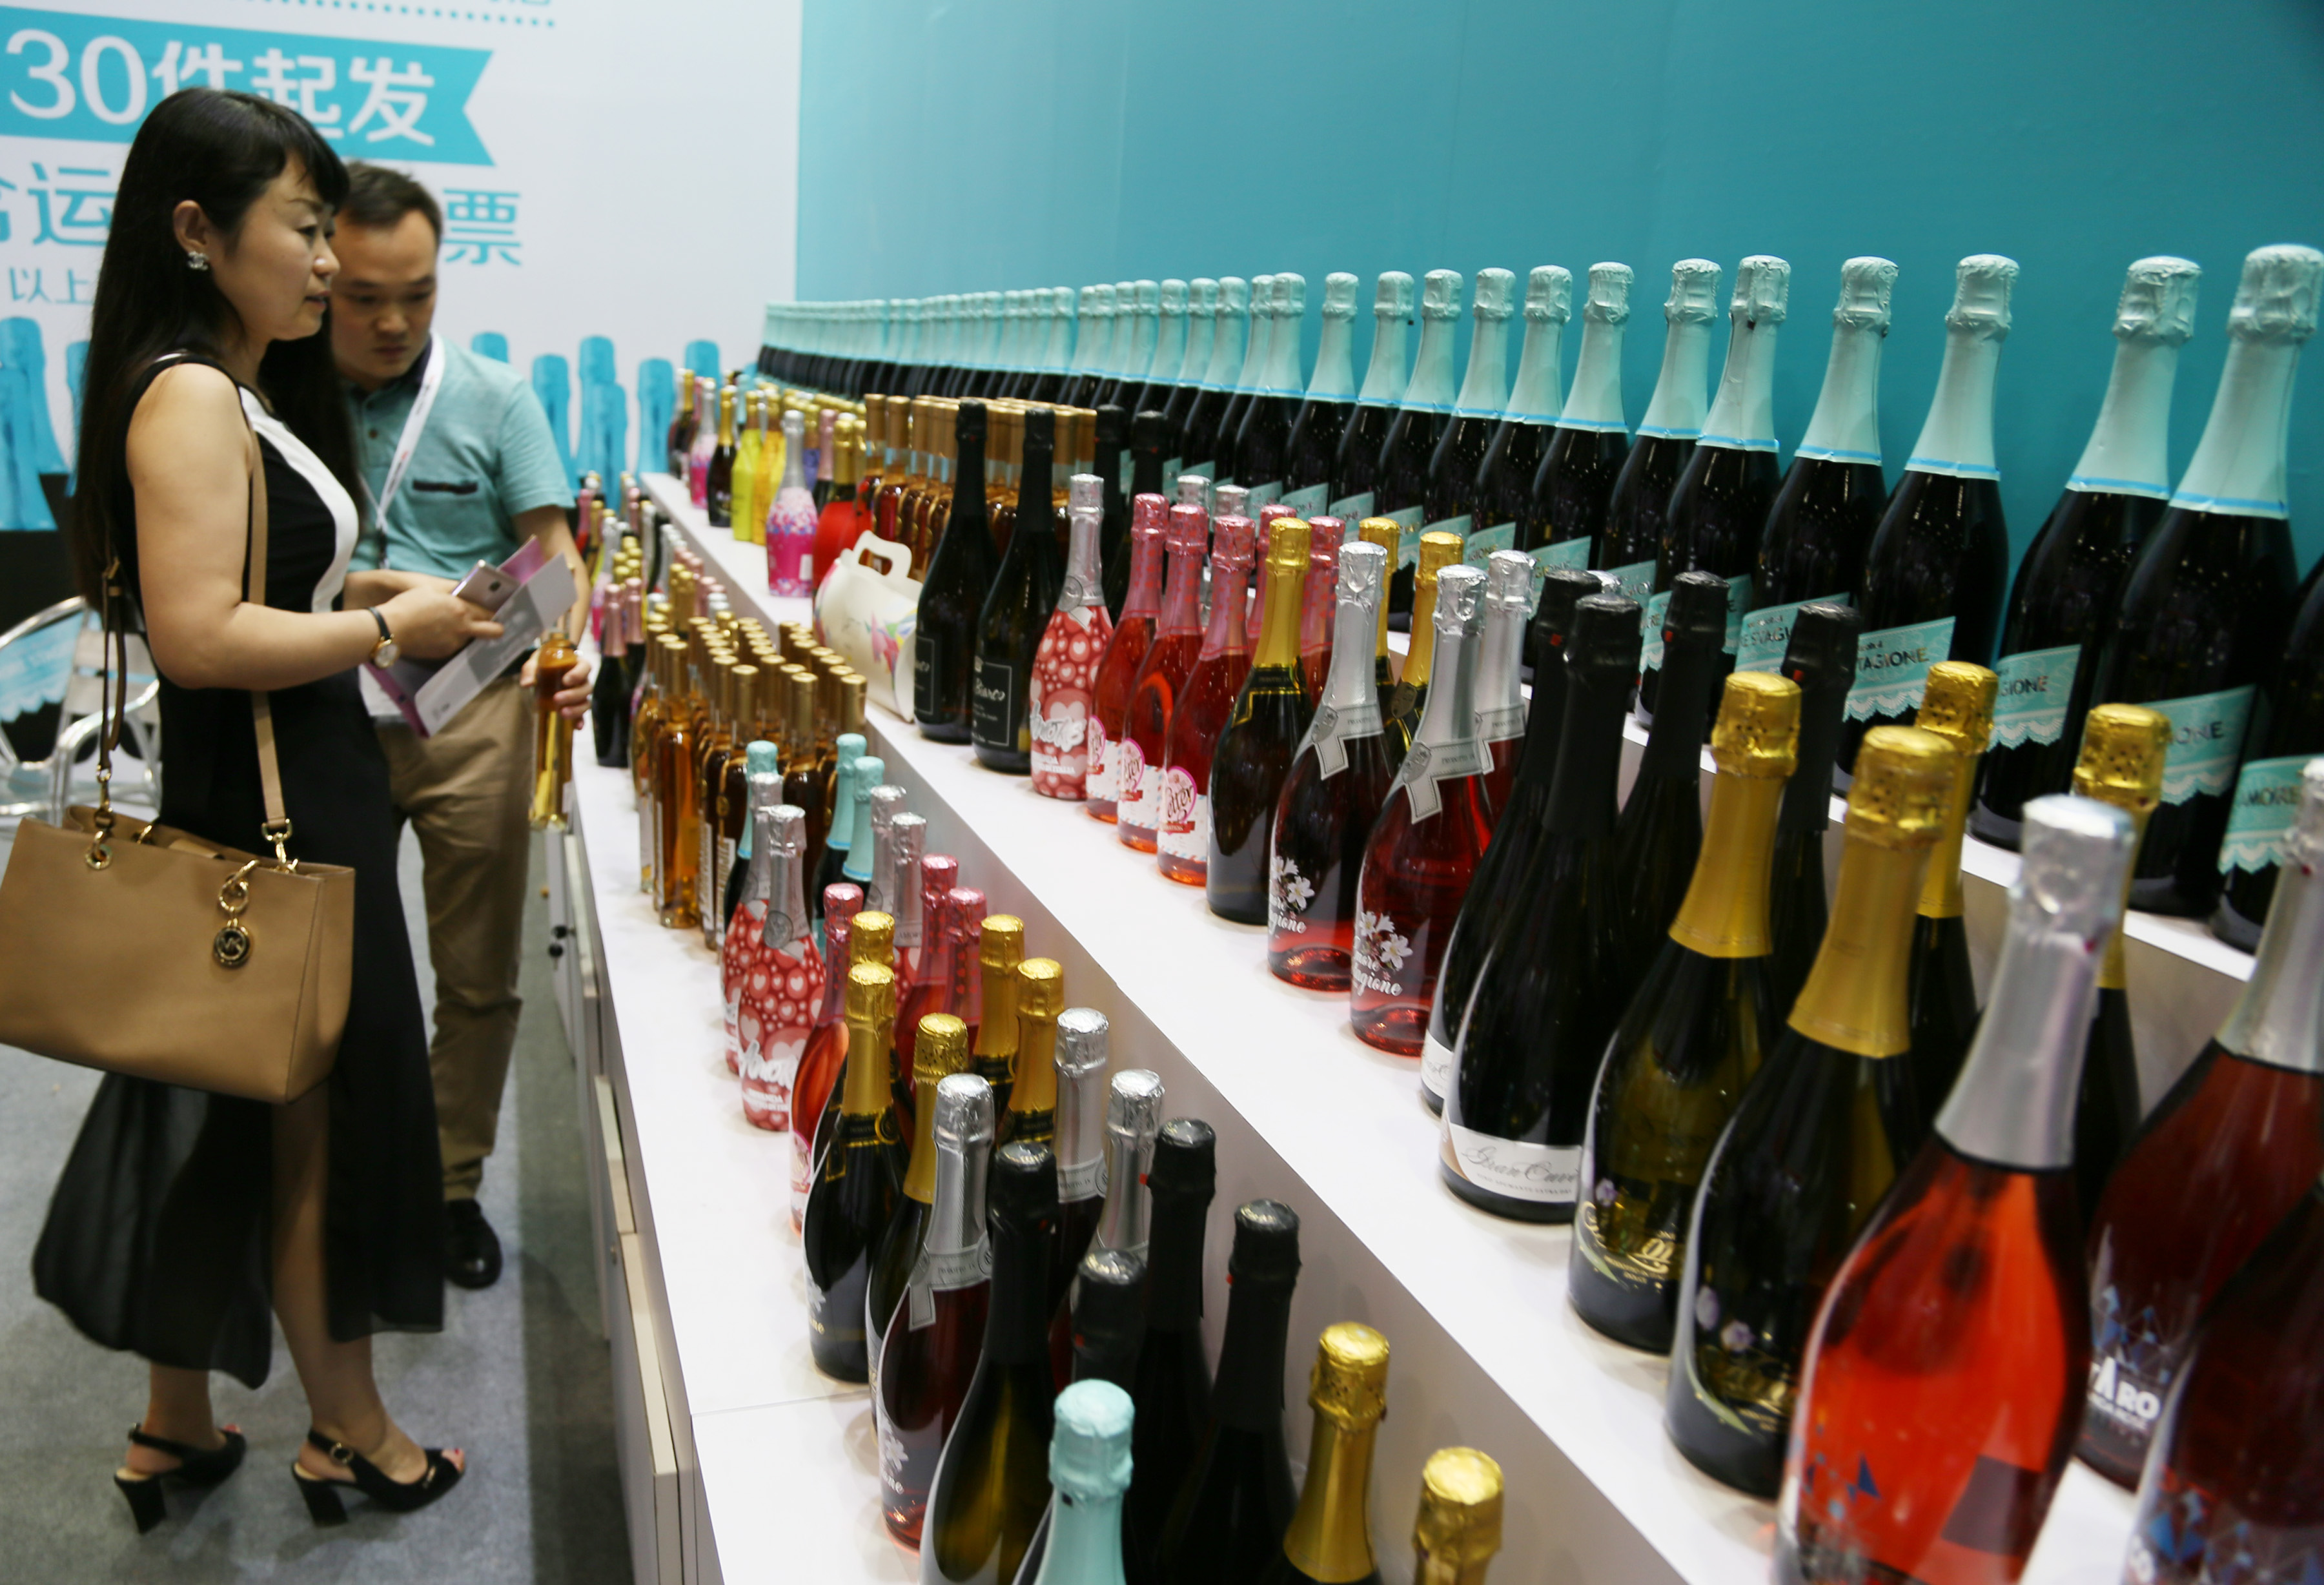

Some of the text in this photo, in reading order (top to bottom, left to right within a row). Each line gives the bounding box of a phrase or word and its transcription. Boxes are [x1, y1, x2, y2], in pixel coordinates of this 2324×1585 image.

[443, 188, 523, 265] 票
[1857, 646, 1930, 672] TAGIONE
[1999, 675, 2048, 697] GIONE
[2175, 721, 2224, 744] ONE
